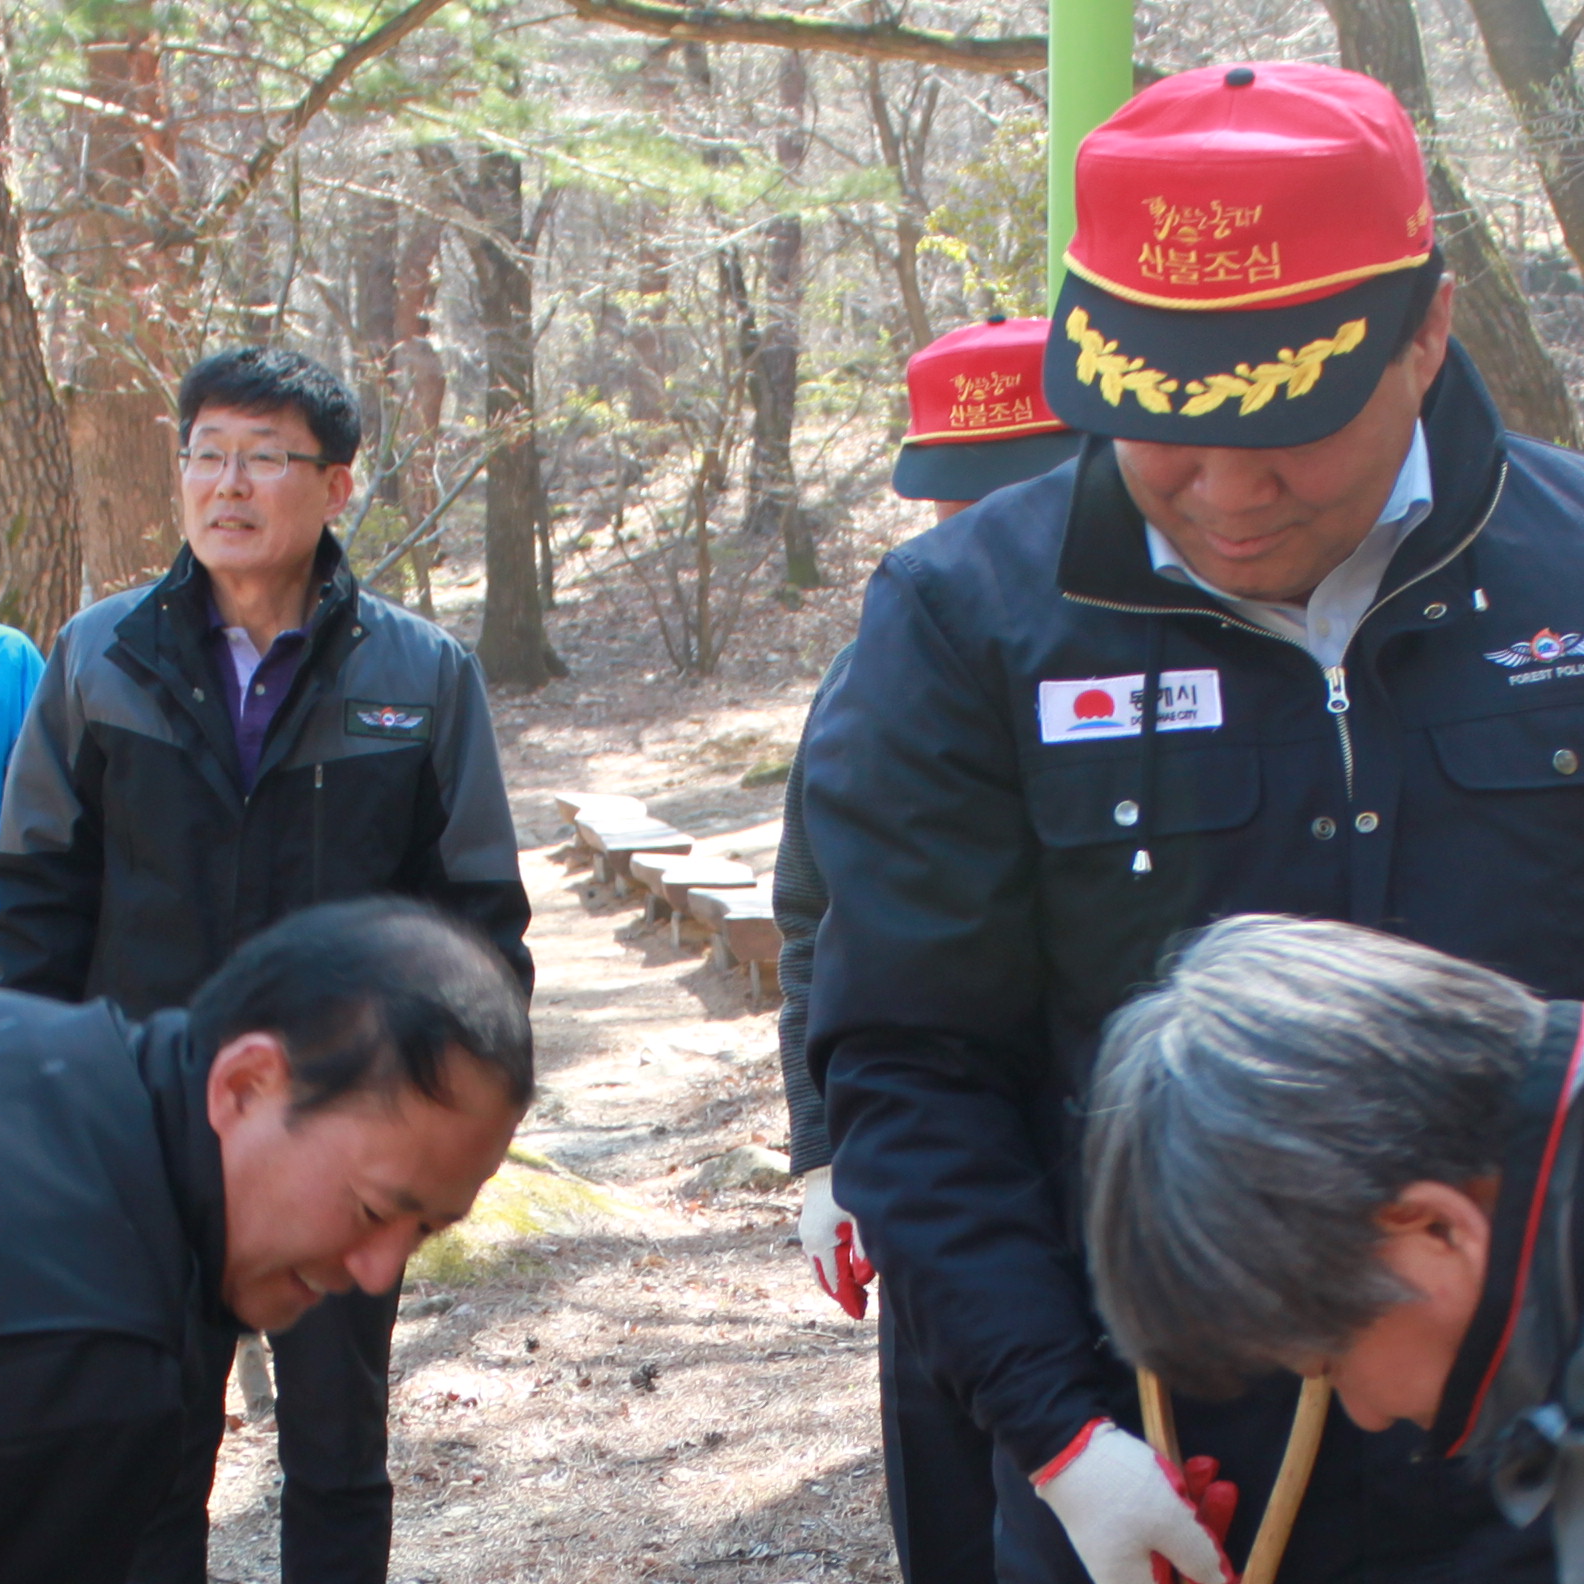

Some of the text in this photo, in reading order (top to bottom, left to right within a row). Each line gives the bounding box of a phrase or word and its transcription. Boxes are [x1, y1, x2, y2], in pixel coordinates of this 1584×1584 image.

[1138, 241, 1281, 285] 산불조심
[949, 395, 1033, 427] 산불조심
[1508, 668, 1553, 686] FOREST
[1176, 709, 1199, 721] CITY
